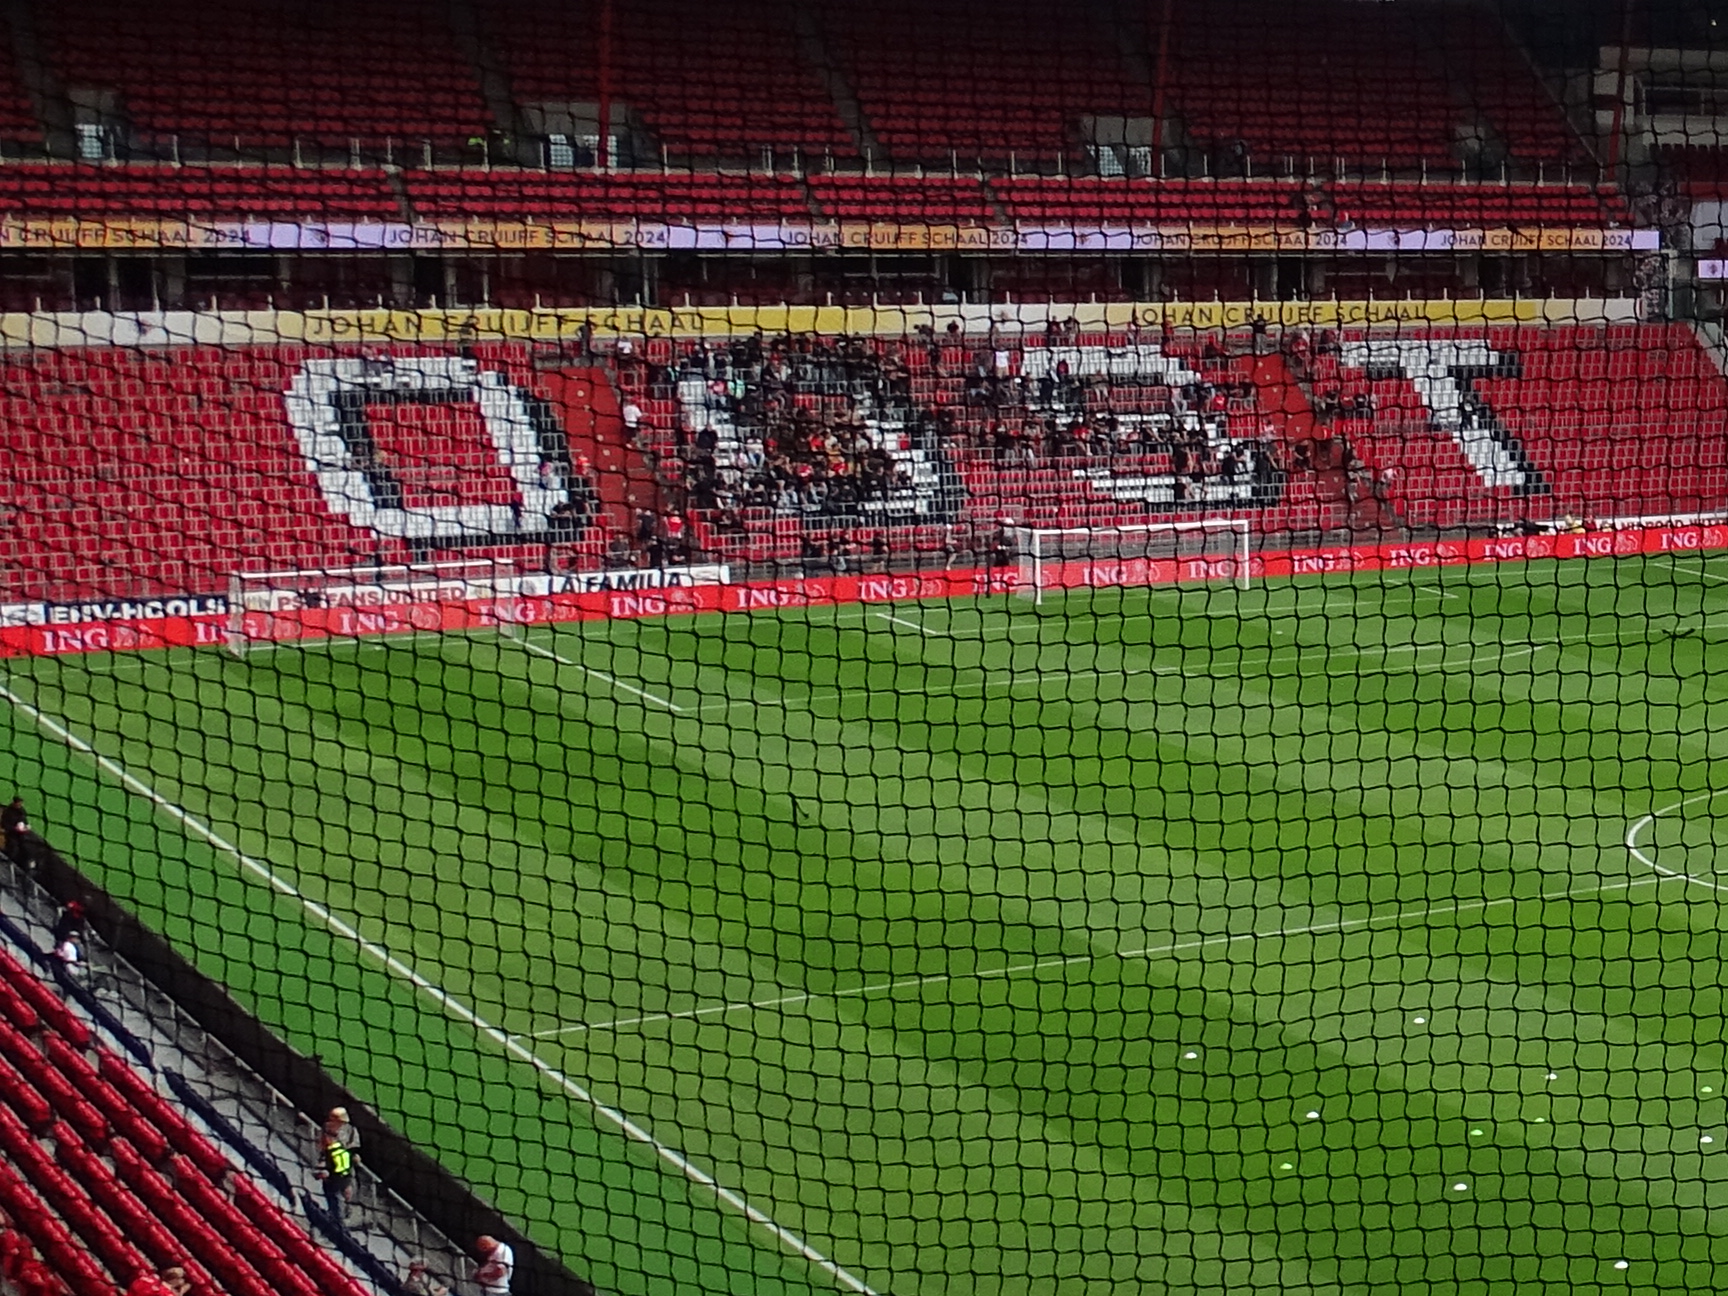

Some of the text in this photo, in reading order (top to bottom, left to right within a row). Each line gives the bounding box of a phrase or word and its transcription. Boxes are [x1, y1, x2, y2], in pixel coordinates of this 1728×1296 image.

[388, 229, 457, 244] JOHAN
[545, 231, 613, 245] SCHAA
[623, 230, 666, 245] 2024
[786, 232, 1028, 246] JOHAN CRUIJFF SCHAAL 2024
[1134, 234, 1186, 246] JOHAN
[1315, 234, 1348, 247] 2024
[1440, 235, 1487, 247] JOHAN
[1547, 236, 1598, 248] SCHAAL
[1603, 236, 1632, 248] 2024
[1131, 307, 1212, 323] OHAN
[1335, 306, 1427, 323] SCHAAL
[313, 315, 422, 333] JOHAN
[579, 571, 682, 592] FAMILIA
[43, 627, 109, 652] ING
[340, 611, 399, 634] ING
[611, 595, 666, 615] ING
[737, 587, 788, 609] ING
[858, 581, 907, 601] ING
[1083, 565, 1127, 585] ING
[1293, 554, 1335, 572] ING
[1390, 549, 1431, 567] ING
[1484, 542, 1523, 561] ING
[1574, 537, 1612, 556] ING
[1661, 531, 1698, 550] ING
[277, 592, 327, 611] PS
